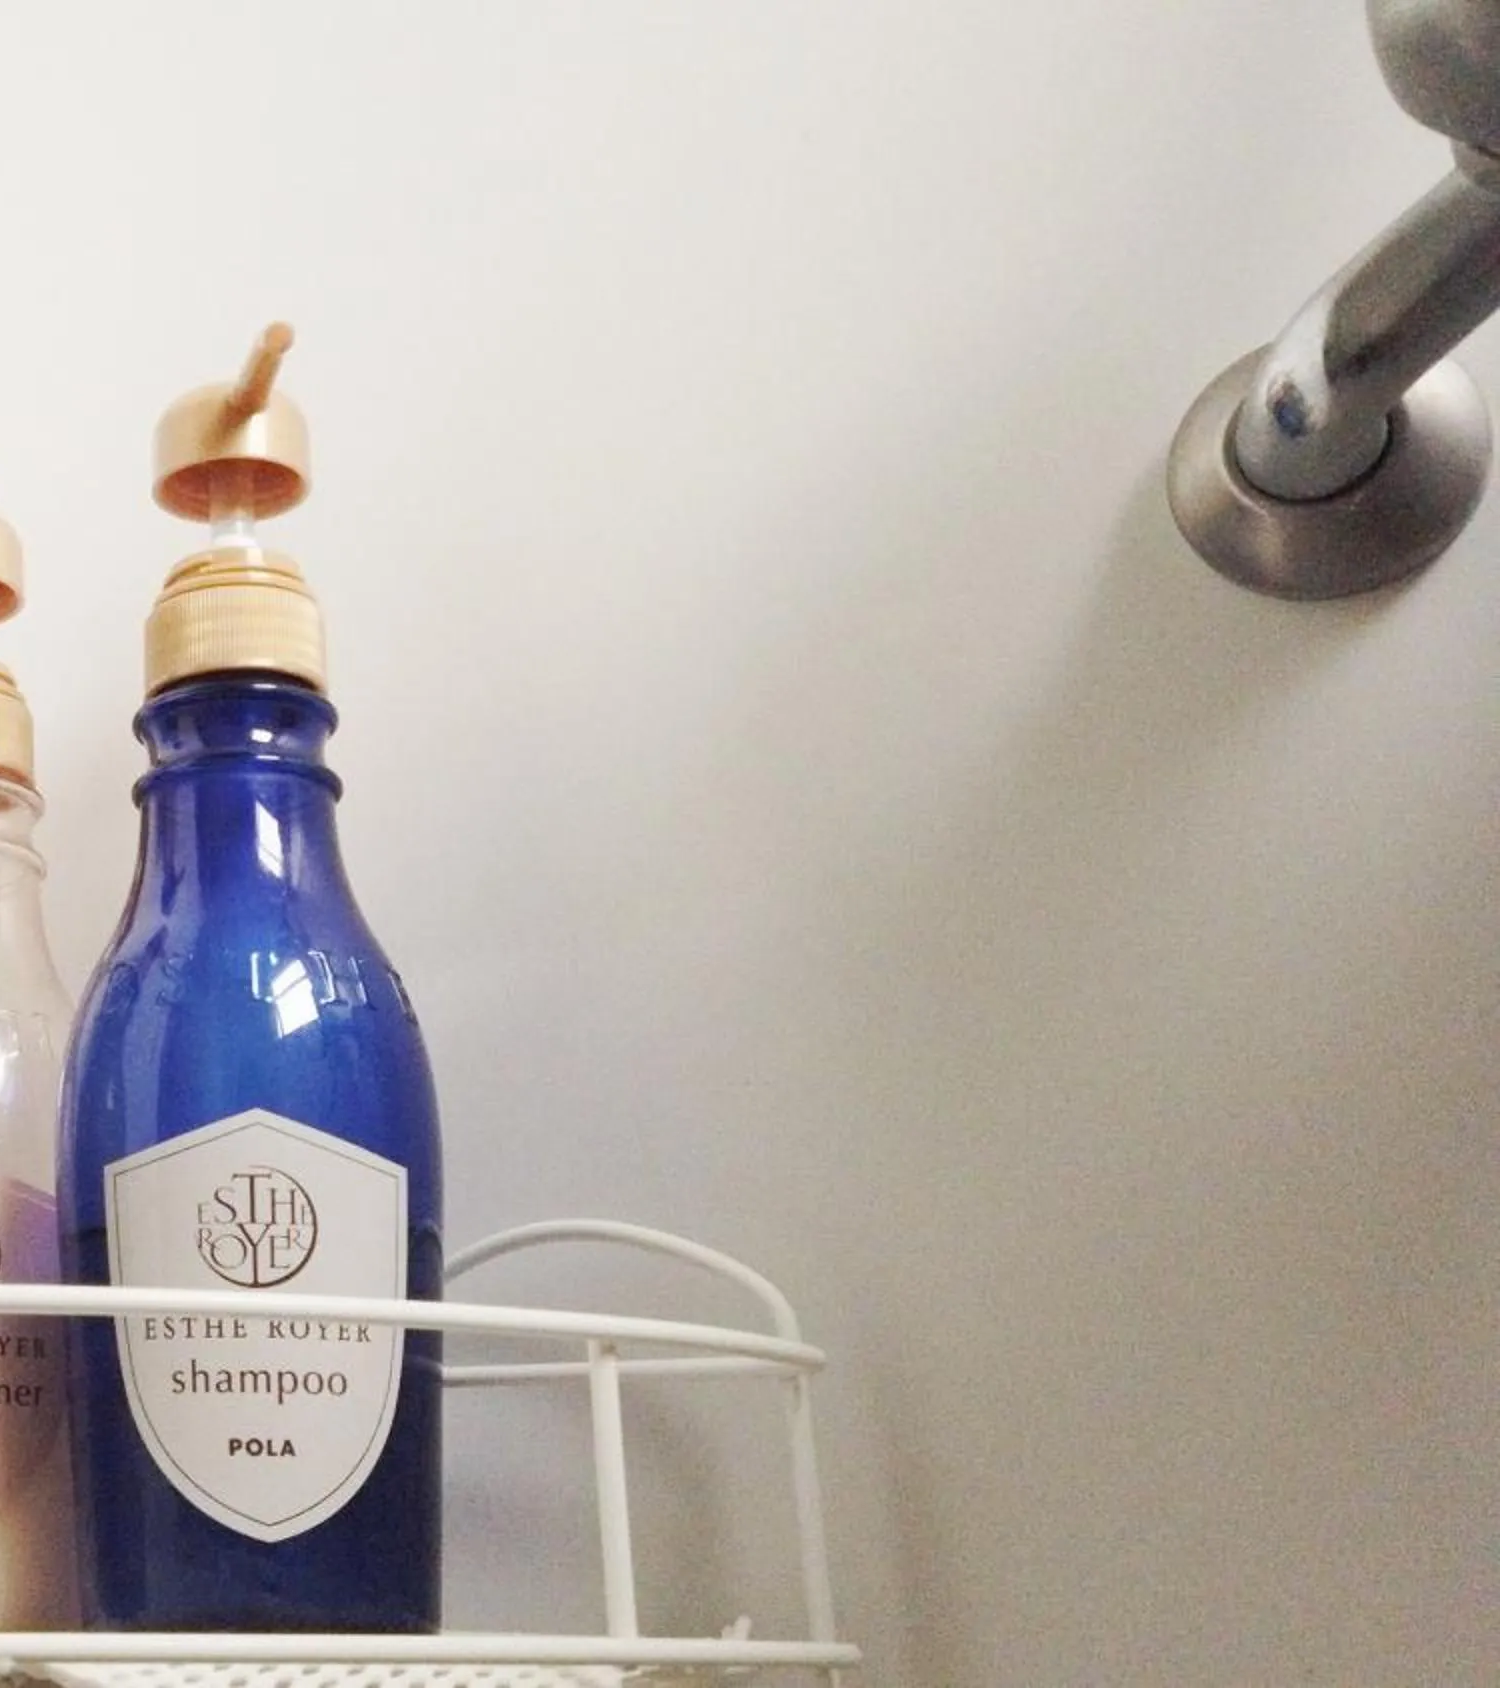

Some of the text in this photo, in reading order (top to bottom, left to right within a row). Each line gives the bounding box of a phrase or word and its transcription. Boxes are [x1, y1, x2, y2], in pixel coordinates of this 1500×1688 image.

[144, 1317, 248, 1341] ESTHE
[171, 1358, 349, 1405] shampoo
[228, 1438, 297, 1458] POLA
